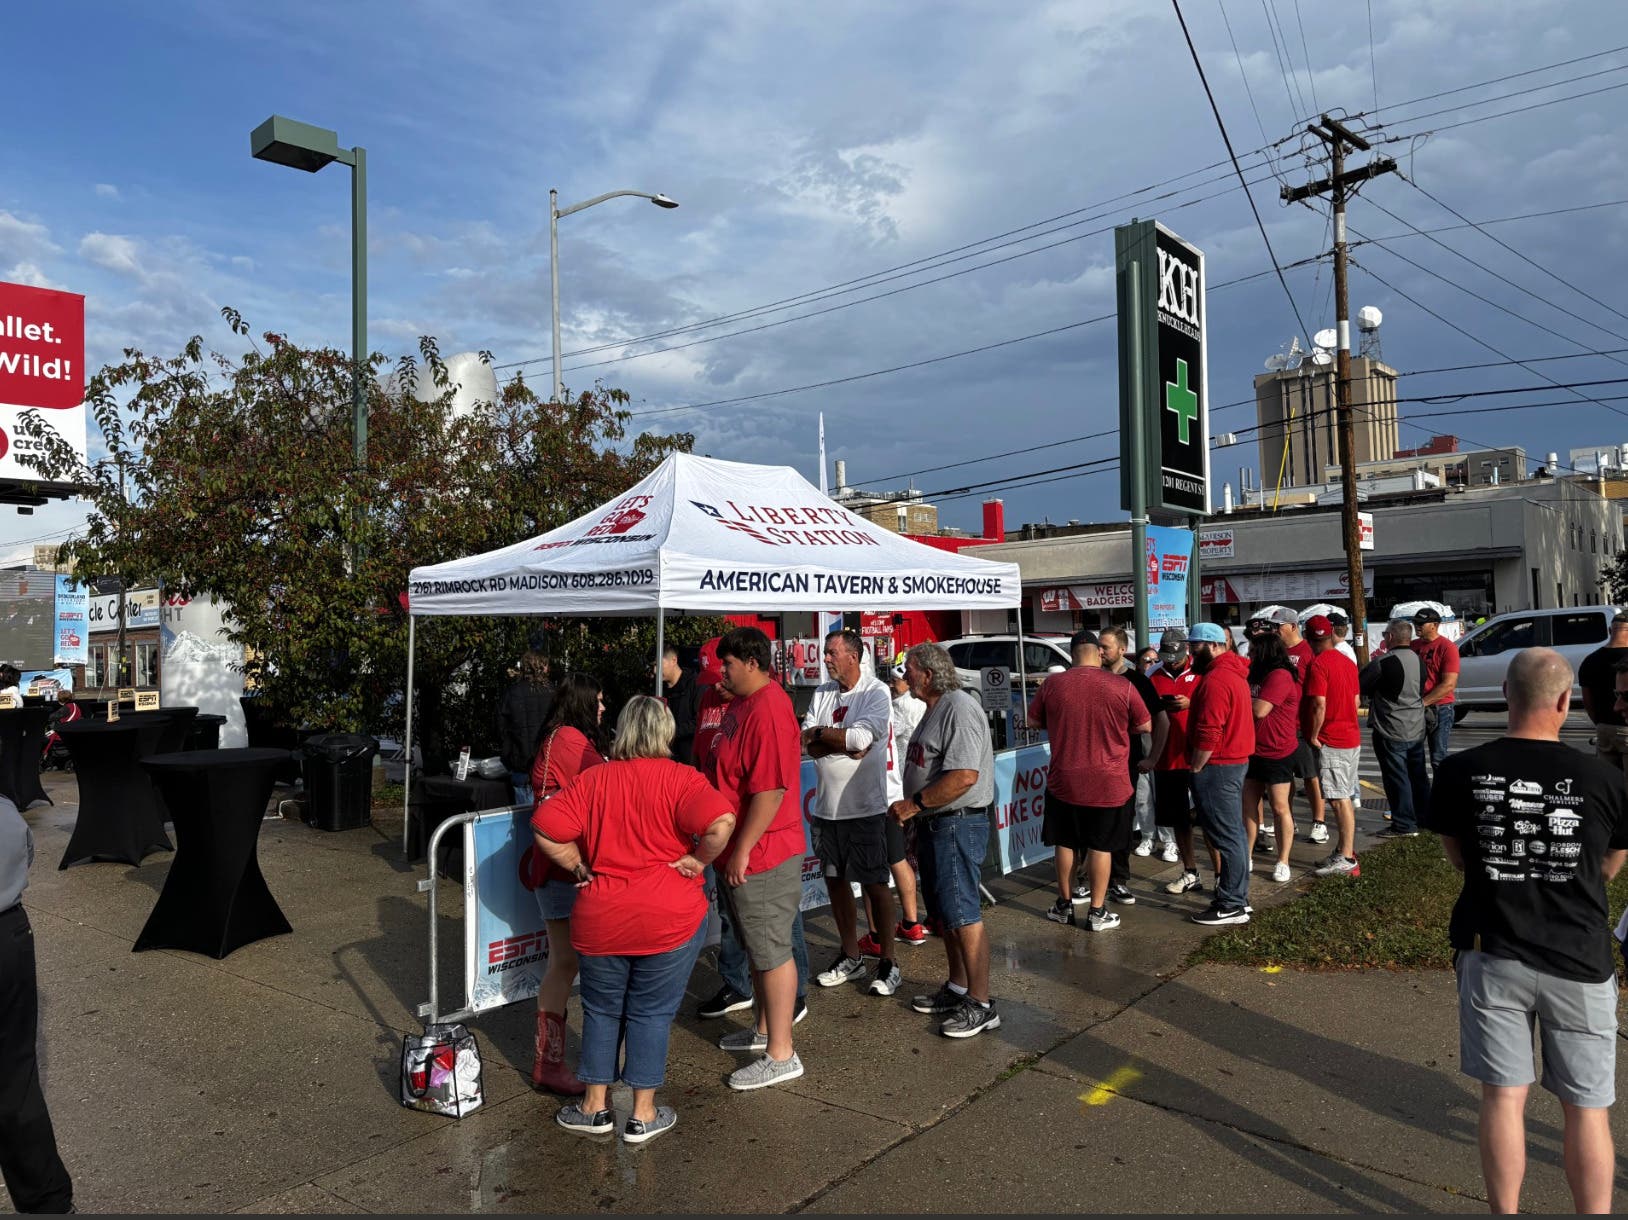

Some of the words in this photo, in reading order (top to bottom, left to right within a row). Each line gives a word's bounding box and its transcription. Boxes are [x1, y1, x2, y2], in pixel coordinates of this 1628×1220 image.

[1157, 247, 1200, 327] KH
[0, 315, 62, 344] llet.
[1162, 475, 1174, 489] 1201
[1175, 477, 1197, 495] REGENT
[614, 495, 654, 511] LET'S
[726, 500, 855, 527] LIBERTY
[569, 534, 658, 547] WISCONSIN
[765, 527, 880, 547] STATION
[413, 581, 432, 594] 2161
[434, 579, 488, 594] RIMROCK
[489, 577, 507, 592] RD
[509, 574, 569, 591] MADISON
[699, 569, 808, 594] AMERICAN
[813, 573, 884, 595] TAVERN
[887, 576, 899, 595] &
[902, 575, 1002, 595] SMOKEHOUSE
[108, 597, 142, 620] Cnter
[1543, 795, 1584, 803] CHALMERS
[995, 798, 1029, 830] LIKE
[1548, 816, 1580, 828] Pizza
[1549, 825, 1574, 836] Hut
[487, 951, 549, 976] WISCONSIN
